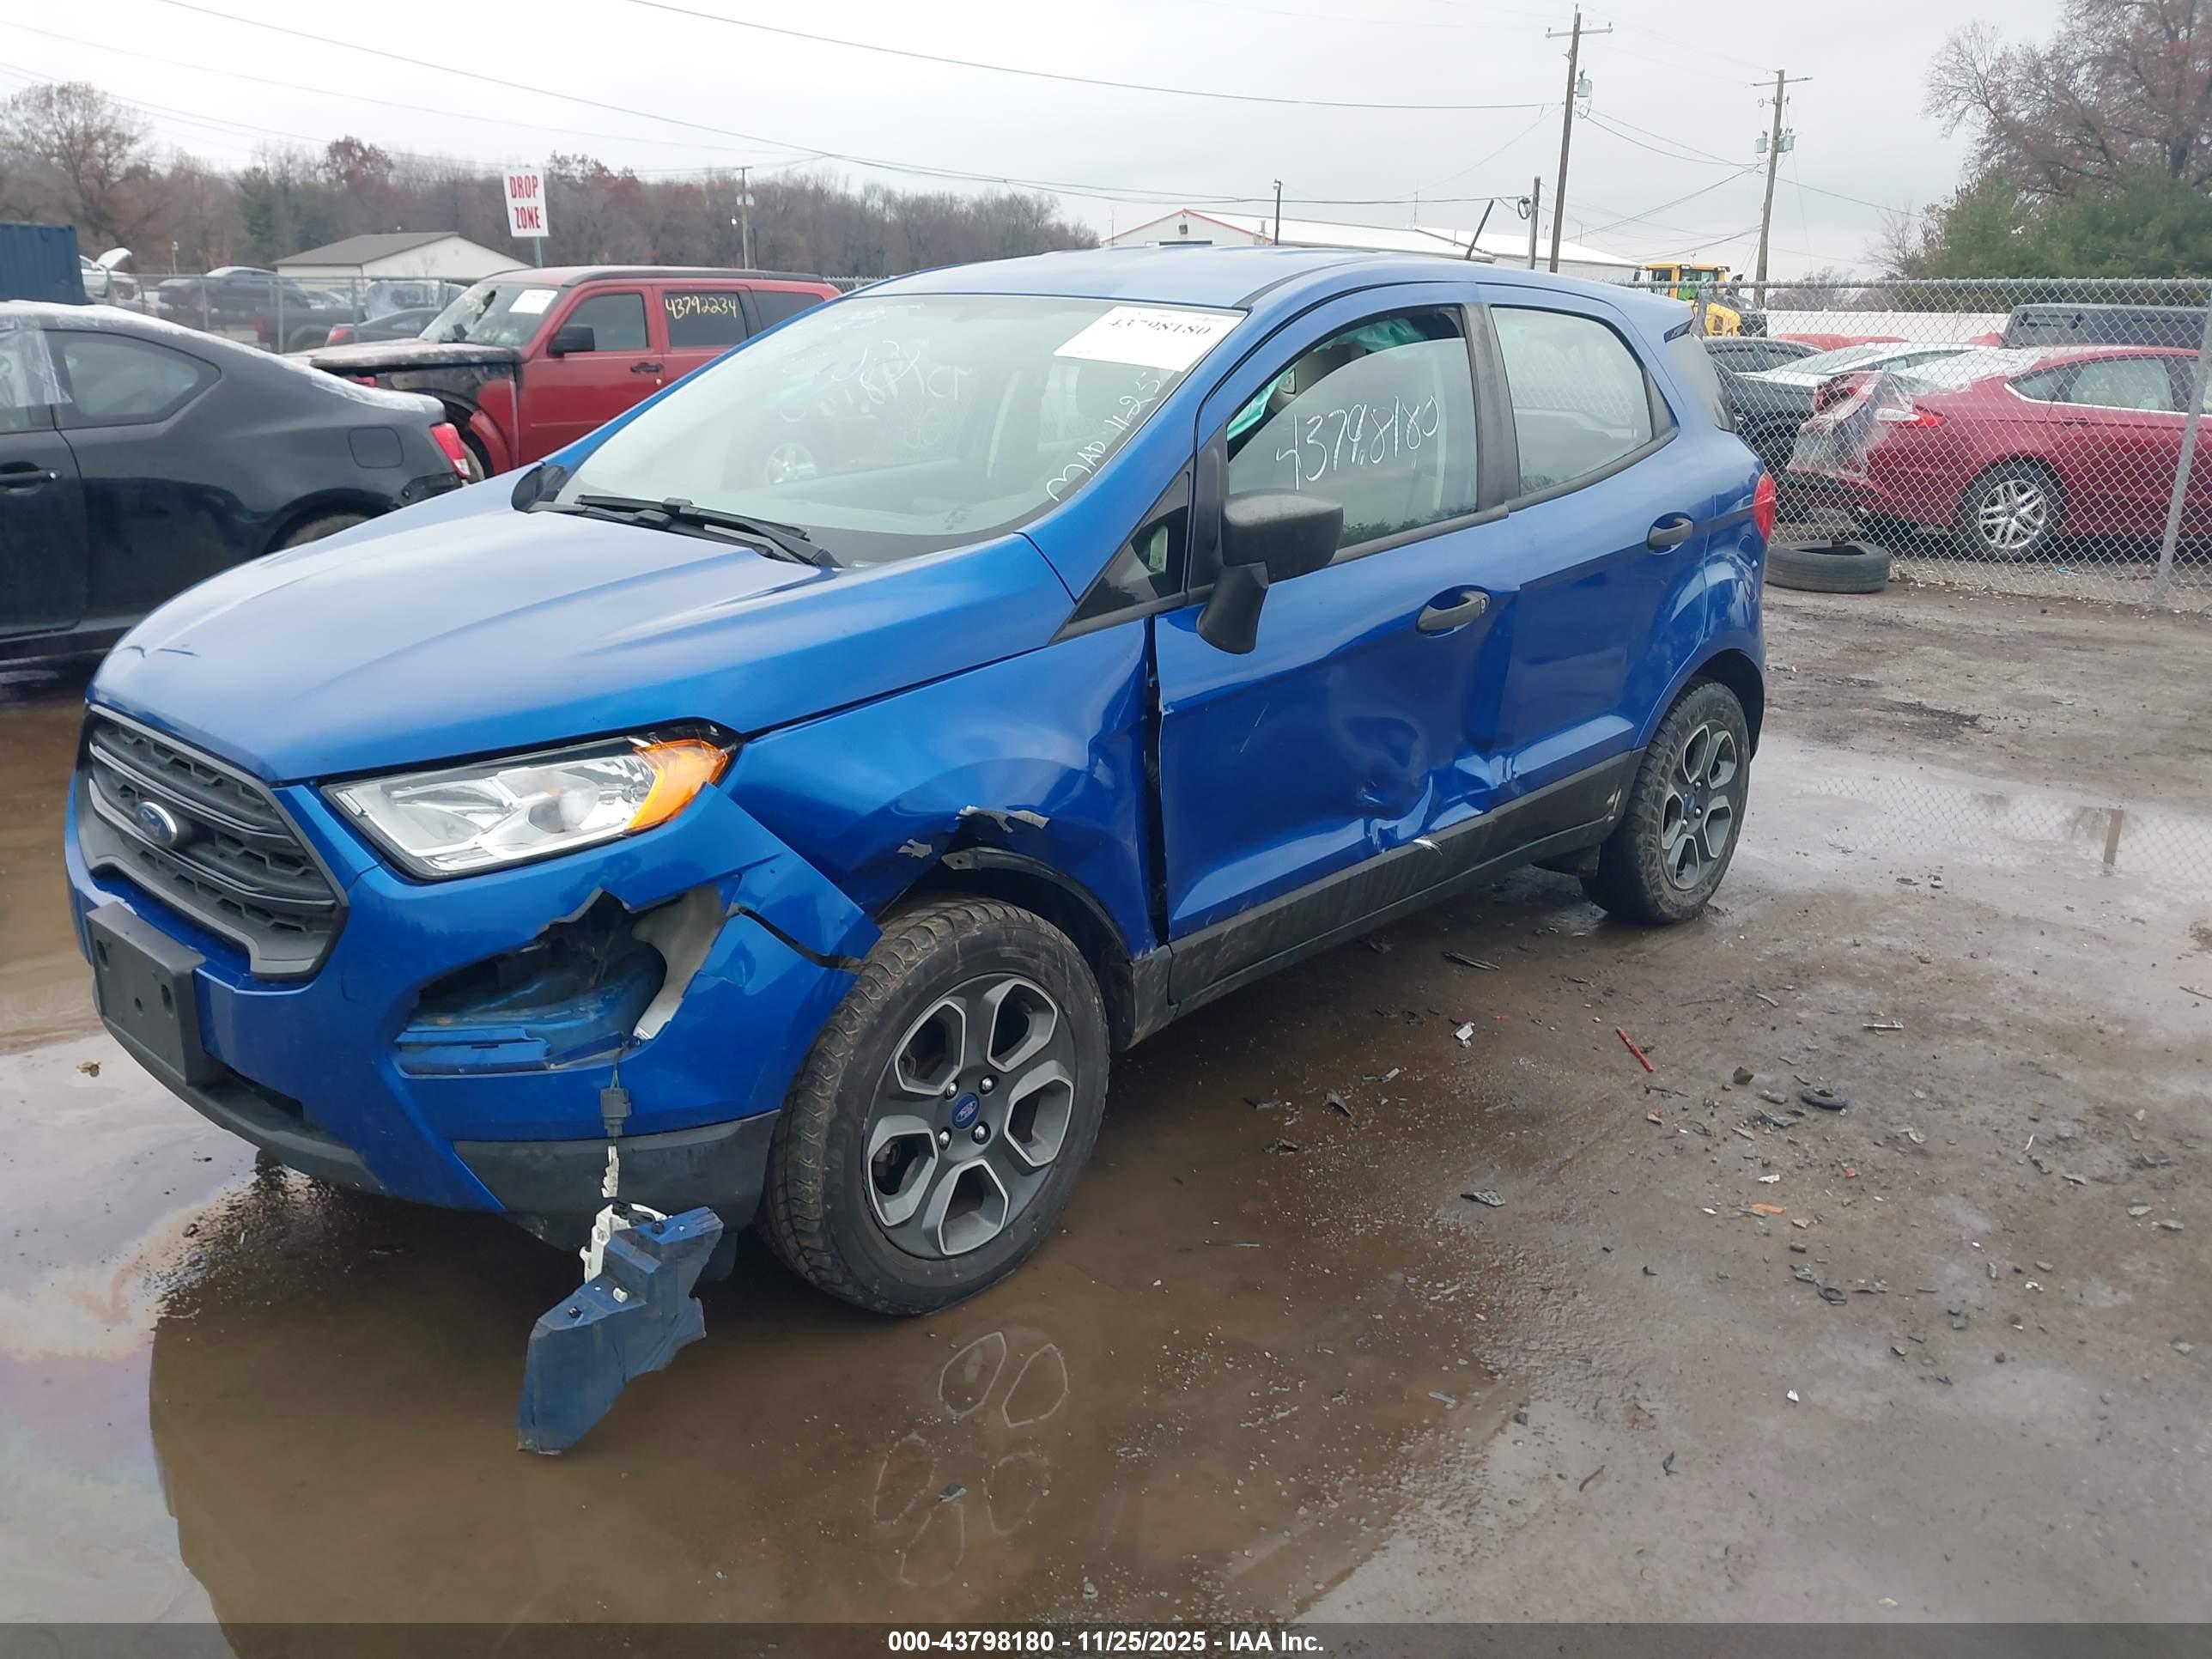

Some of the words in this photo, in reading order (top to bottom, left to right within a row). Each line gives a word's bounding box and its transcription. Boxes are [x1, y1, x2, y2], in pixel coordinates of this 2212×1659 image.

[509, 174, 538, 199] DROP
[514, 205, 541, 229] ZONE
[665, 295, 738, 319] 43792234
